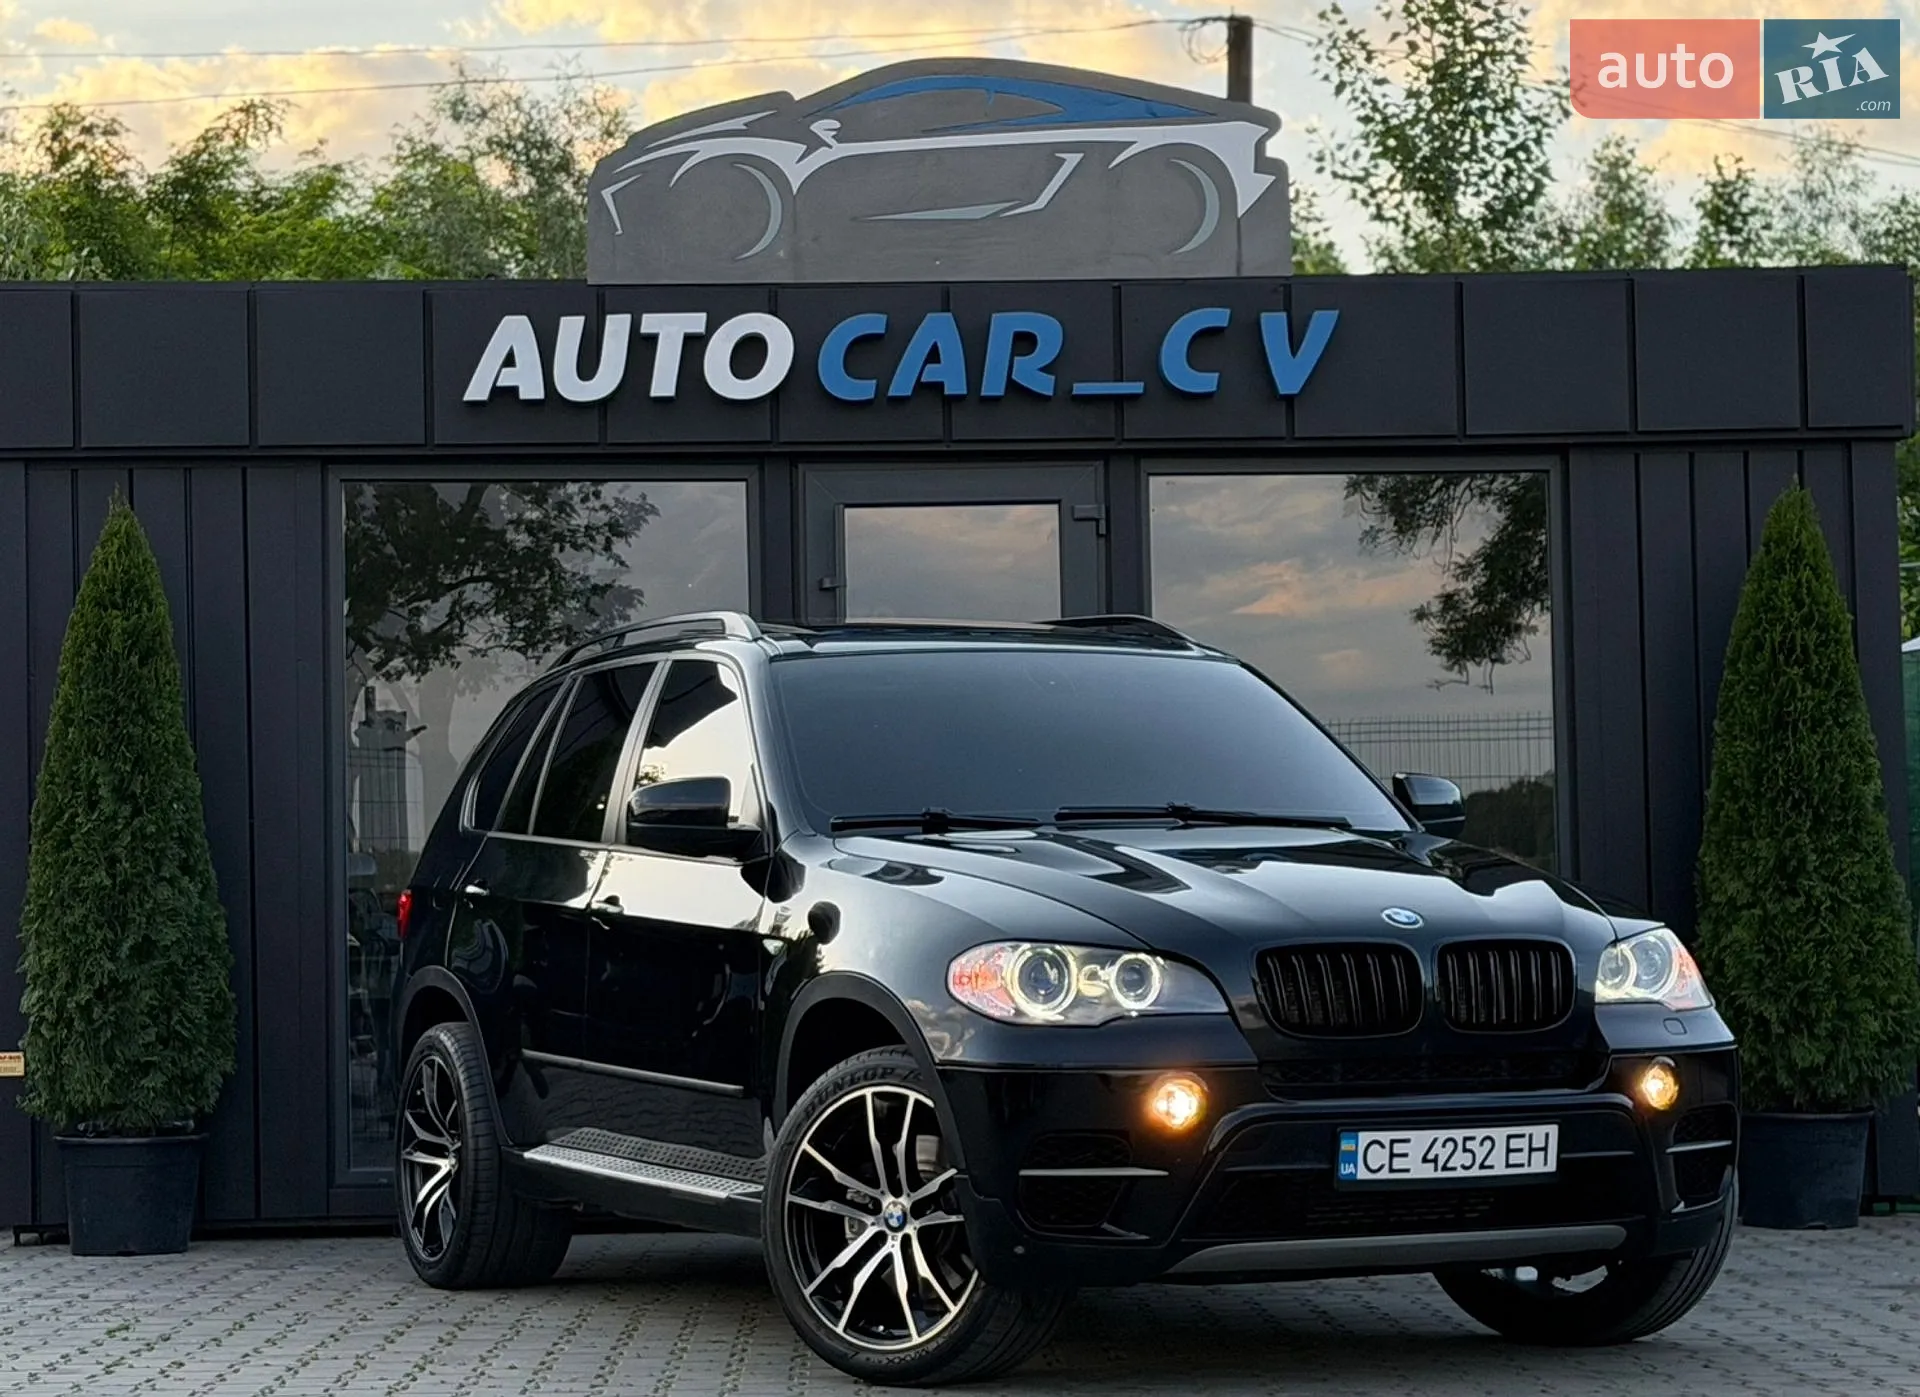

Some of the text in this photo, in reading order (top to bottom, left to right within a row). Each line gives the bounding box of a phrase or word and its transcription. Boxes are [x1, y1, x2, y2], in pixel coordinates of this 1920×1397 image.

[463, 312, 795, 402] AUTO
[1340, 1163, 1356, 1175] UA
[1362, 1132, 1550, 1174] CE 4252 EH
